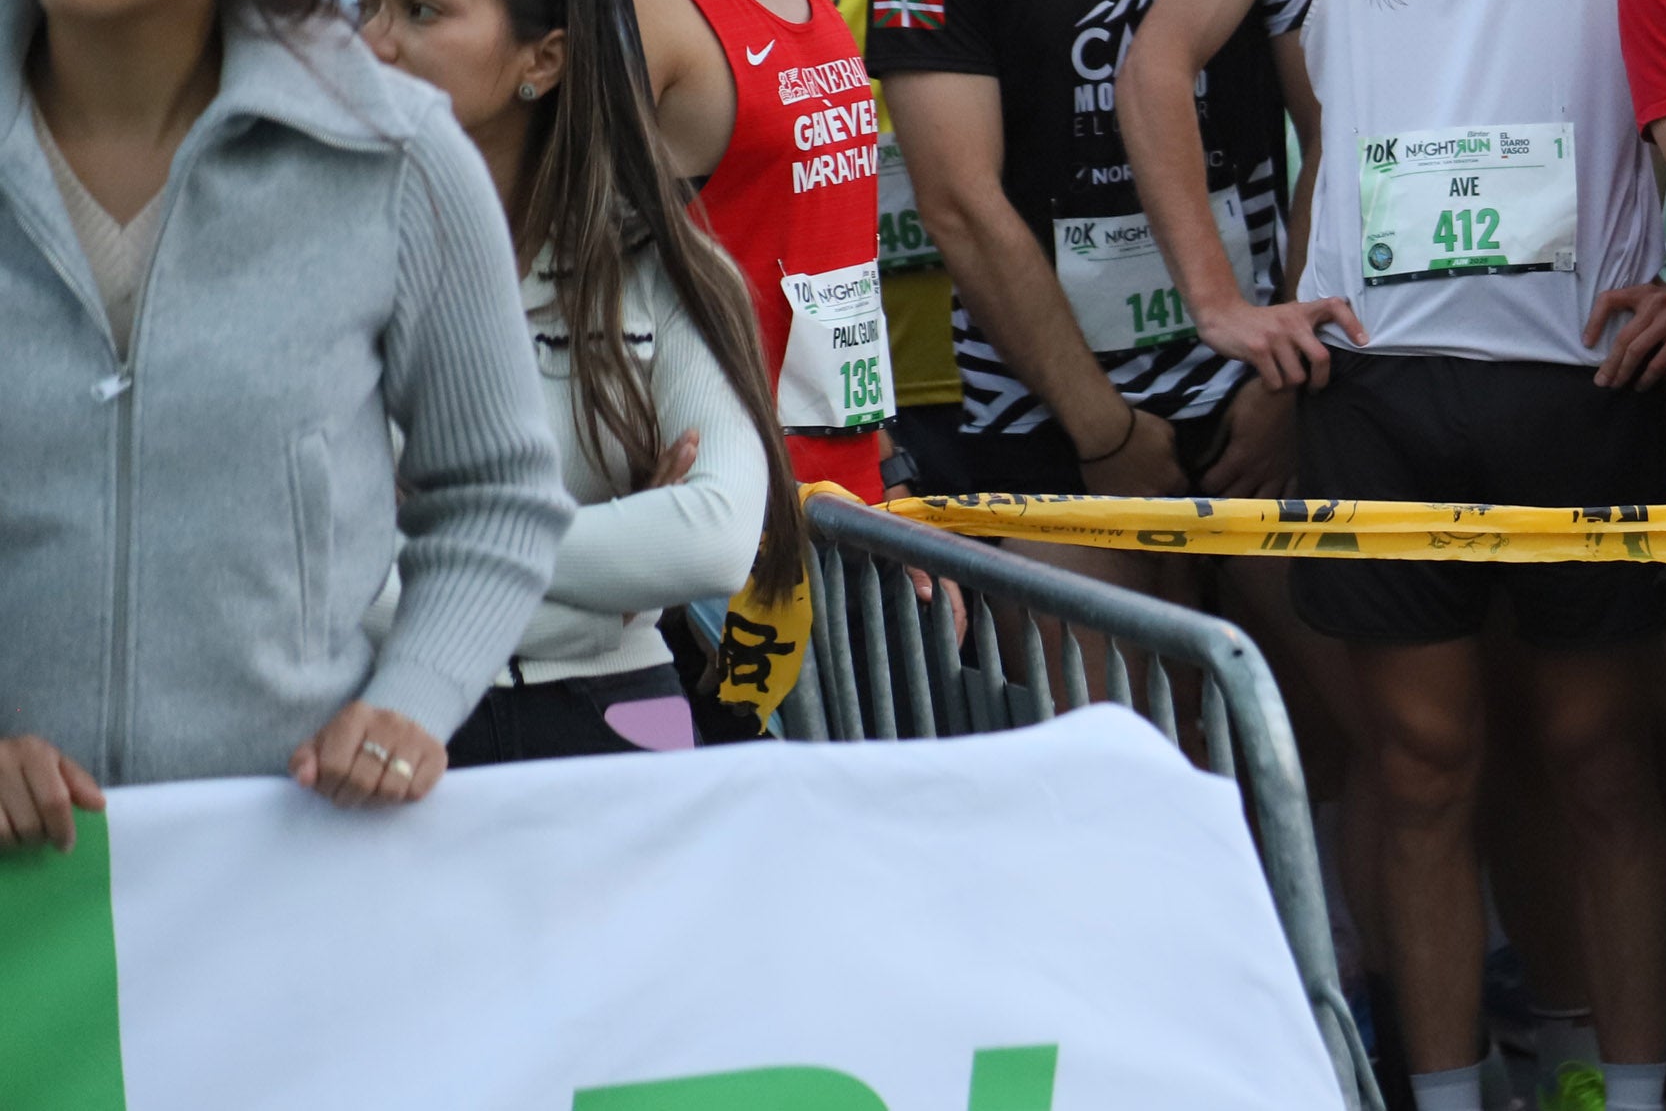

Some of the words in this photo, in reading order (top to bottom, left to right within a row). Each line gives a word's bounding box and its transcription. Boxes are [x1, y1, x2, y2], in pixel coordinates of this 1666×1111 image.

[1365, 138, 1399, 164] 10K
[1500, 139, 1530, 147] DIARIO
[1500, 147, 1530, 155] VASCO
[1554, 138, 1564, 159] 1
[1449, 176, 1480, 197] AVE
[1064, 223, 1098, 248] 10K
[1104, 223, 1152, 243] NIGHT
[1432, 208, 1500, 252] 412
